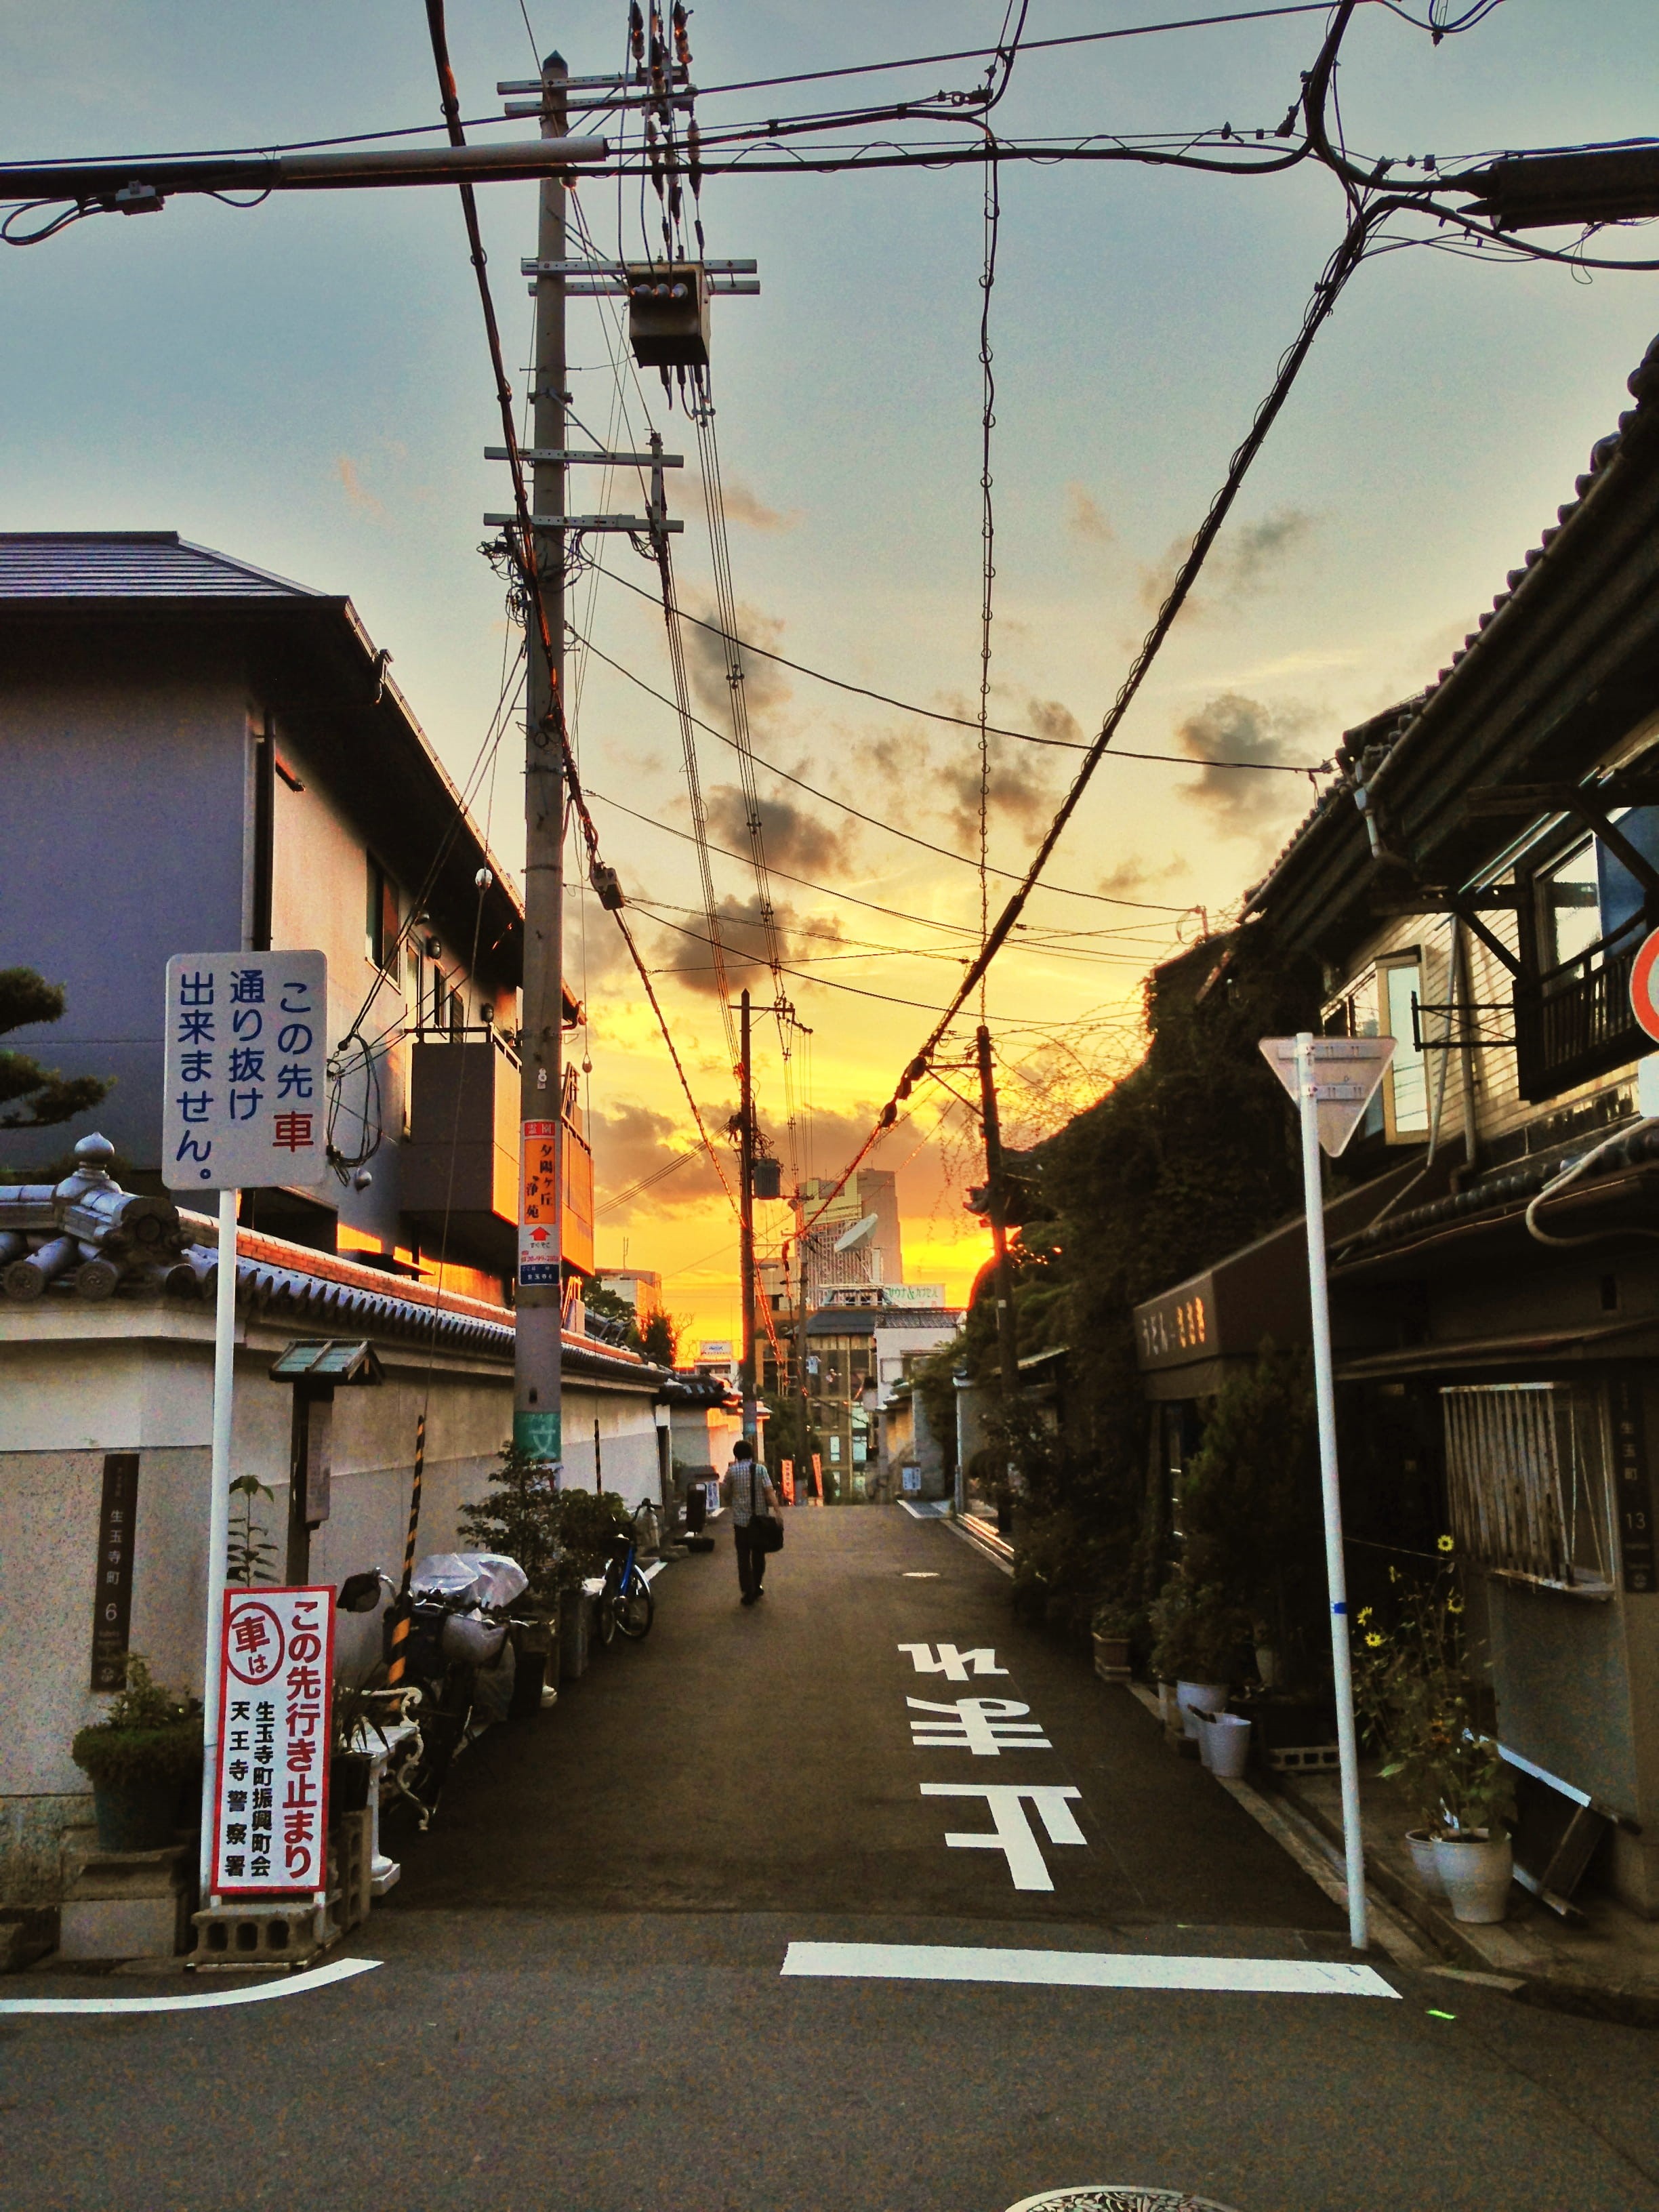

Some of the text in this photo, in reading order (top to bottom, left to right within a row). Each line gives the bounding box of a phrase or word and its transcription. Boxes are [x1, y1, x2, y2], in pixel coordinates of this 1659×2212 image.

[176, 971, 215, 1180] 出来ません。
[228, 970, 266, 1120] 通り抜け
[272, 982, 314, 1153] この先車
[108, 1509, 124, 1586] 生玉寺町
[1626, 1513, 1646, 1530] 13
[105, 1603, 117, 1622] 6
[231, 1614, 270, 1676] 車は
[224, 1700, 251, 1877] 天王寺警察署
[250, 1700, 275, 1877] 生玉寺町振興町会
[282, 1601, 322, 1879] この先行き止まり
